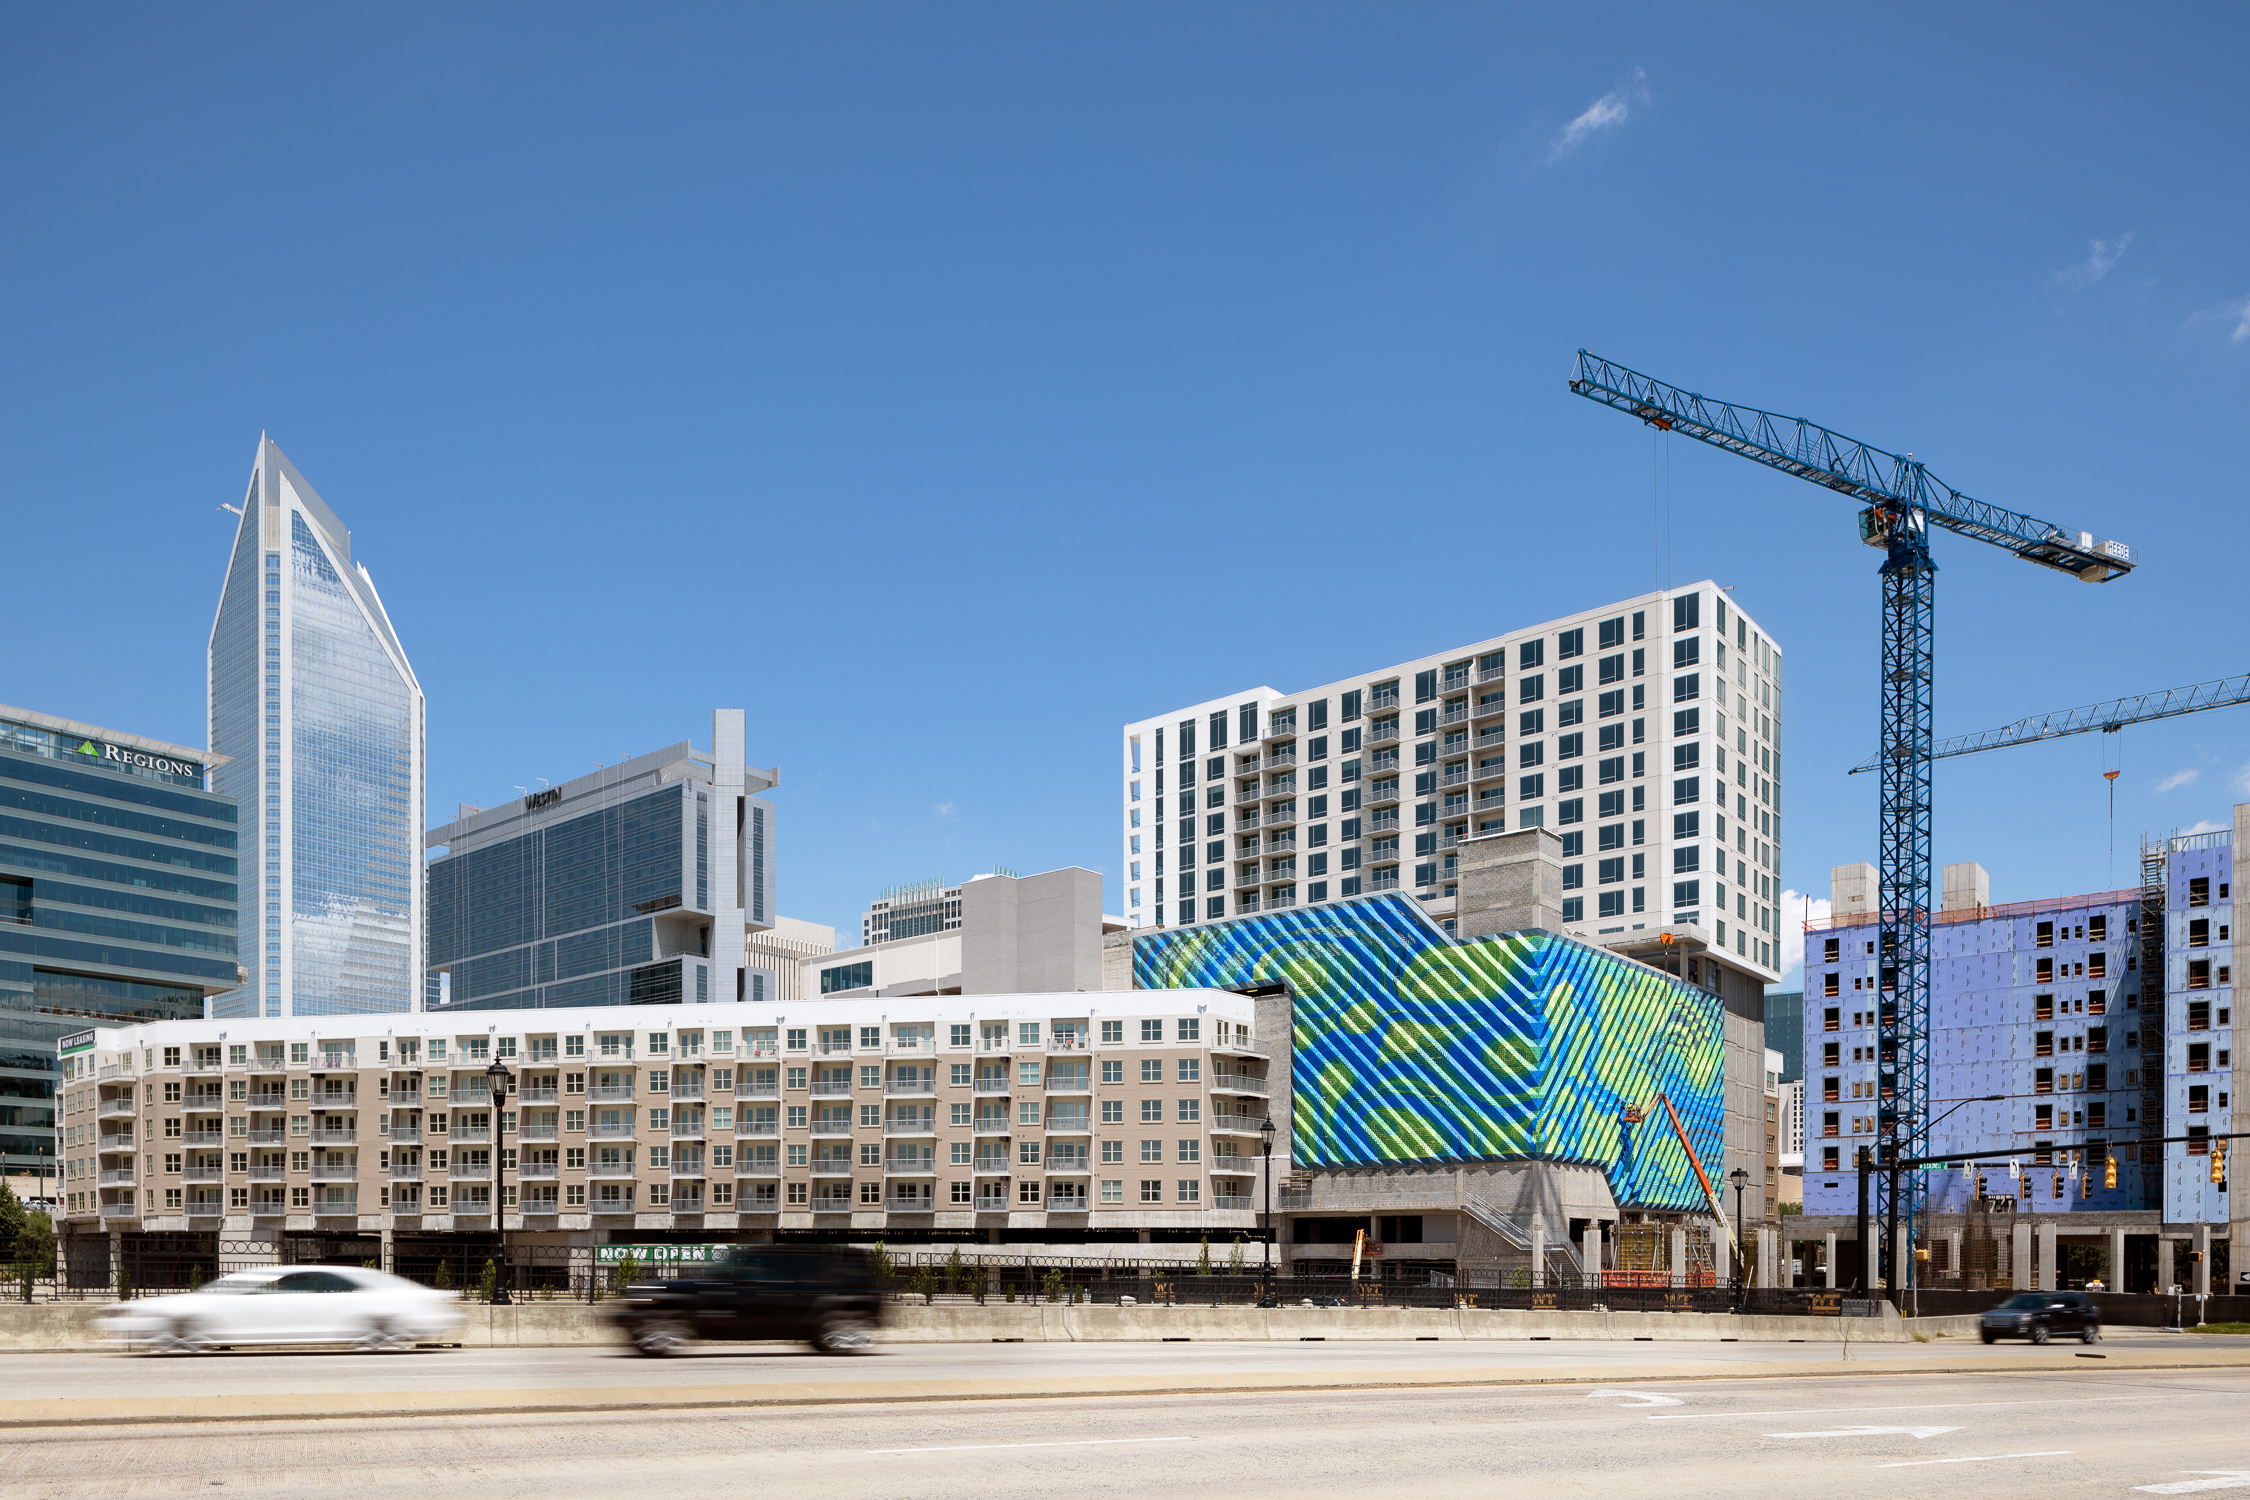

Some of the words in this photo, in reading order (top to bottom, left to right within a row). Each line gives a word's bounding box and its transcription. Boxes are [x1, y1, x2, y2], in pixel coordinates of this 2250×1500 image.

[2109, 541, 2128, 558] HEEDE
[104, 743, 193, 777] REGIONS
[524, 786, 562, 811] WESTIN
[62, 1039, 73, 1049] NOW
[74, 1033, 94, 1046] LEASING
[600, 1247, 649, 1261] NOW
[653, 1246, 706, 1261] OPEN
